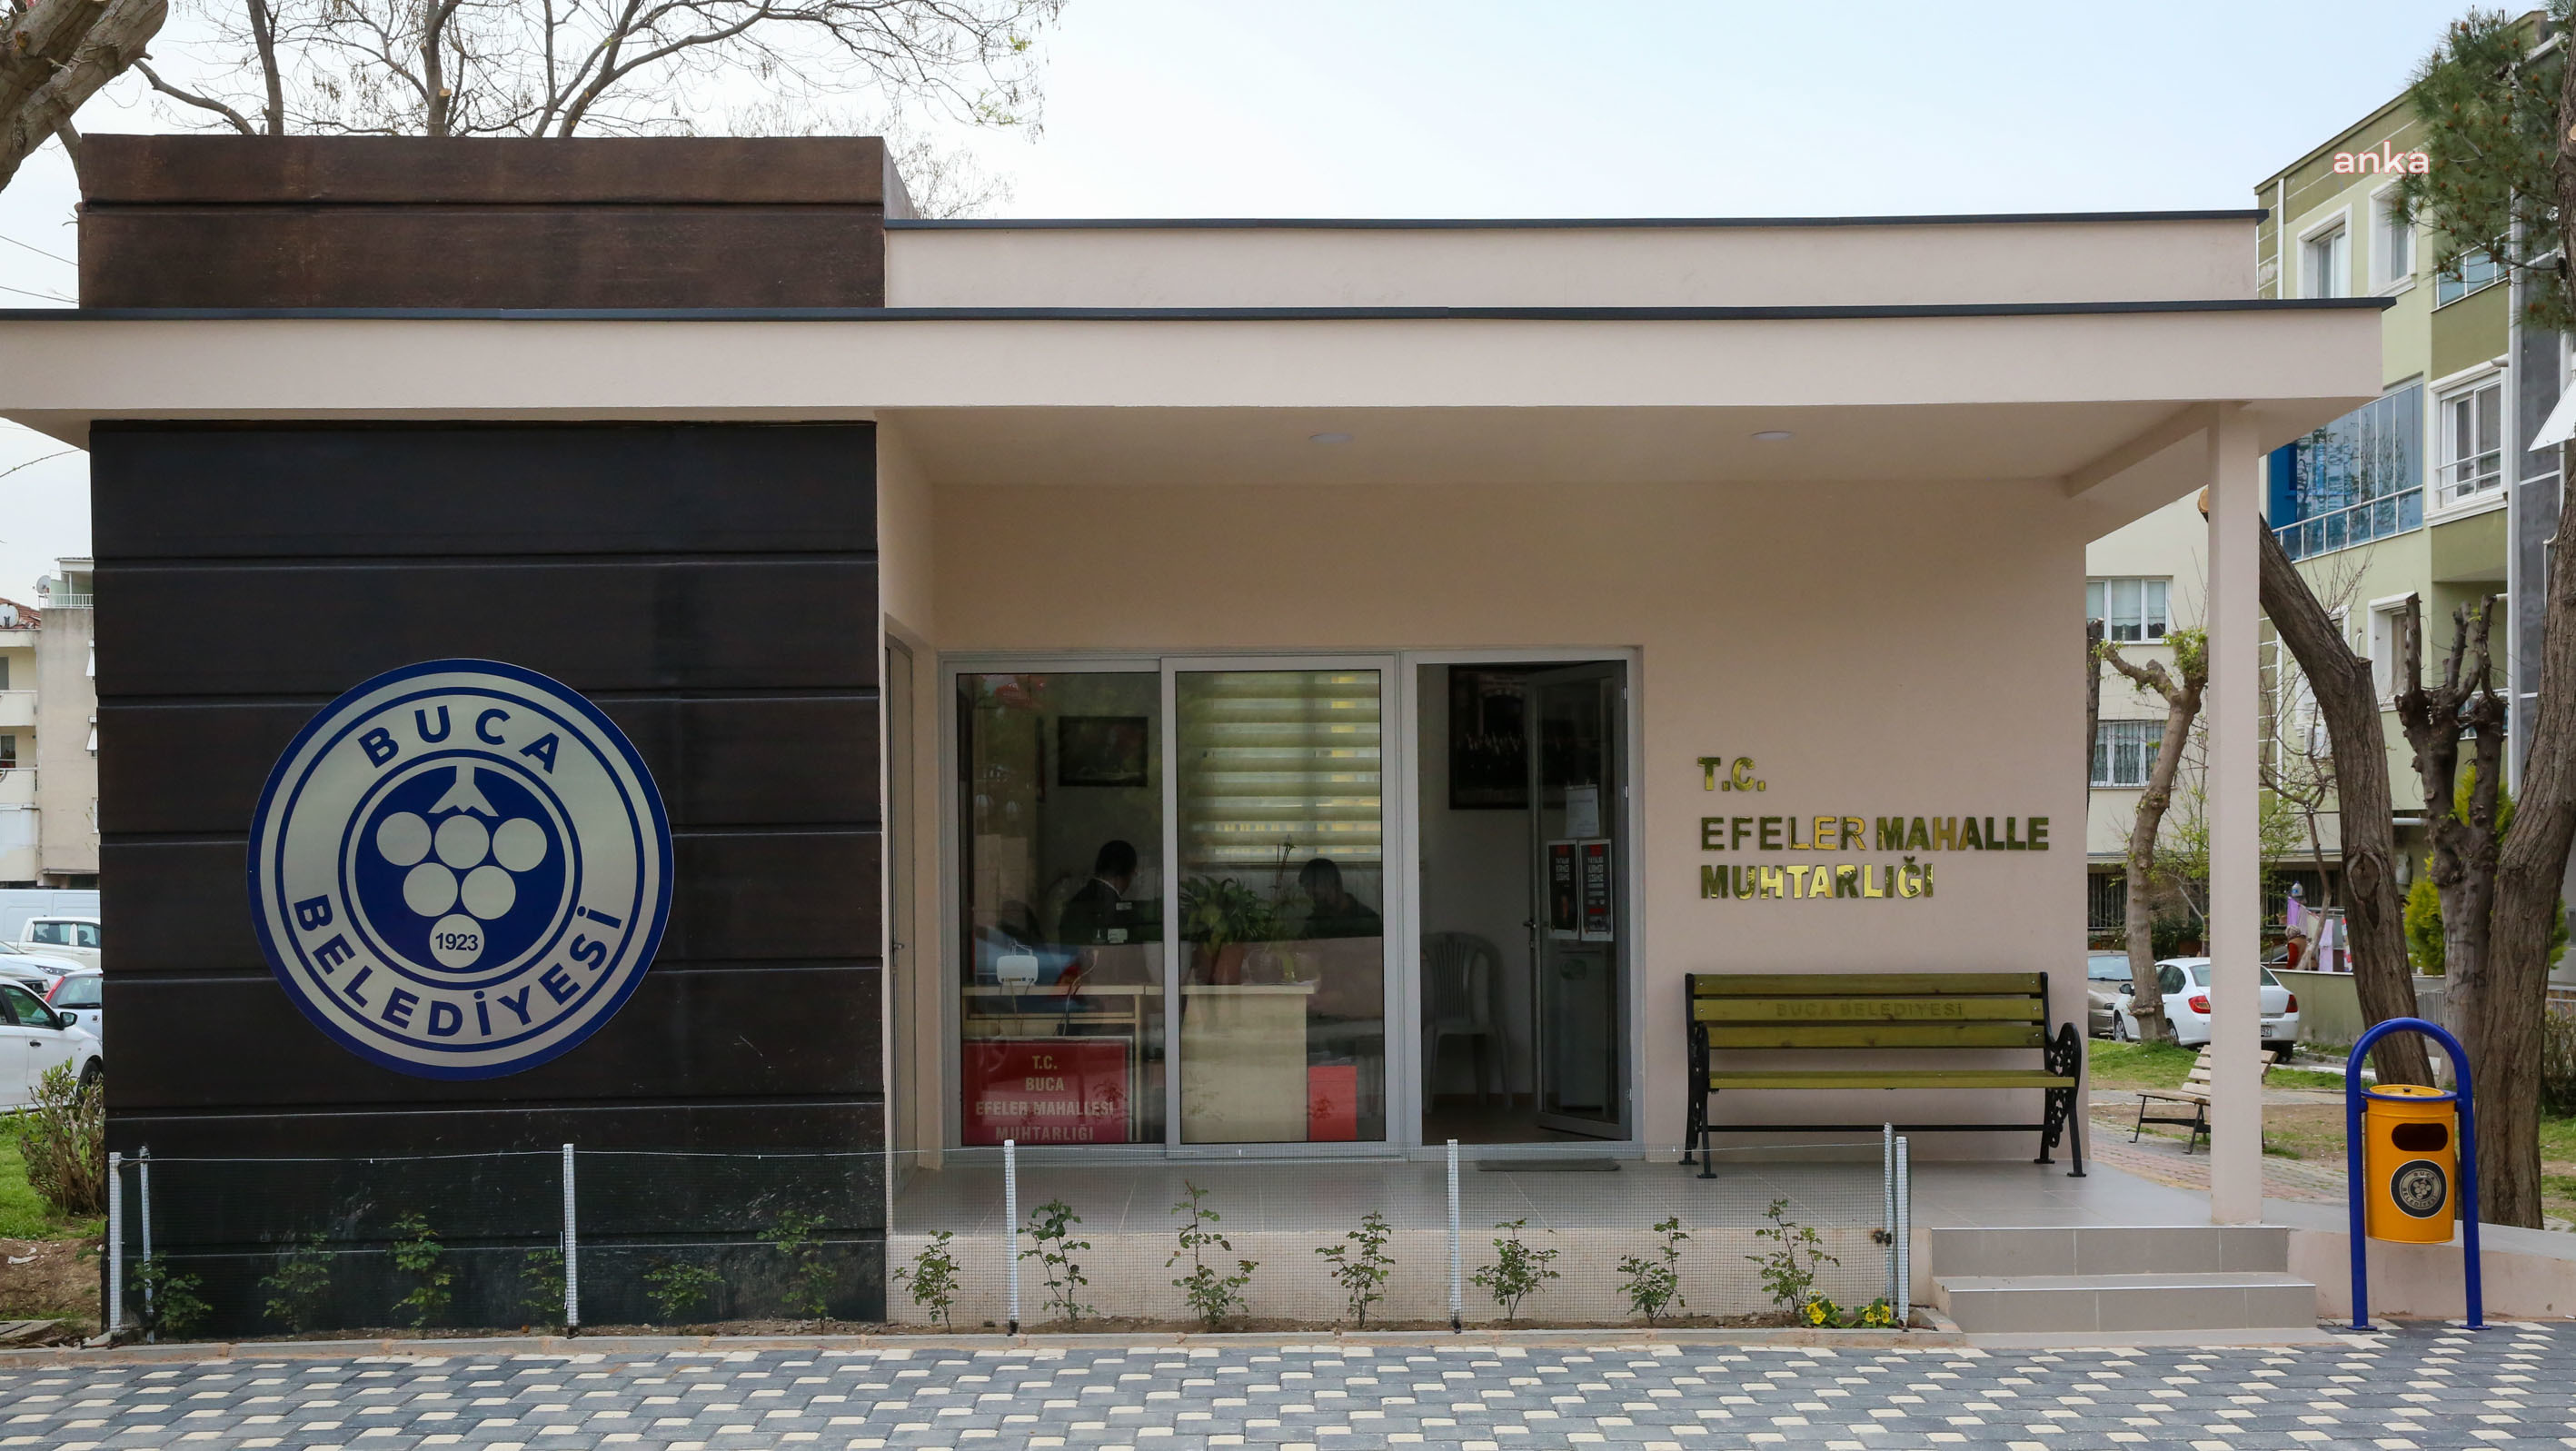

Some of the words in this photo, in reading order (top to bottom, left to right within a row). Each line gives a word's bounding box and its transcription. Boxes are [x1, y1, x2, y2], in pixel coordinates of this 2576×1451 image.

[357, 705, 560, 774] BUCA
[1697, 756, 1766, 791] T.C.
[1701, 816, 1867, 851] EFELER
[1875, 816, 2050, 851] MAHALLE
[1700, 856, 1934, 899] MUHTARLIĞI
[434, 932, 479, 951] 1923
[293, 894, 622, 1037] BELEDİYESİ
[1775, 1002, 1832, 1017] BUCA
[1032, 1055, 1058, 1069] T.C.
[1025, 1077, 1064, 1091] BUCA
[975, 1100, 1029, 1116] EFELER
[1033, 1098, 1113, 1116] MAHALLESİ
[995, 1124, 1094, 1140] MUHTARLIĞI
